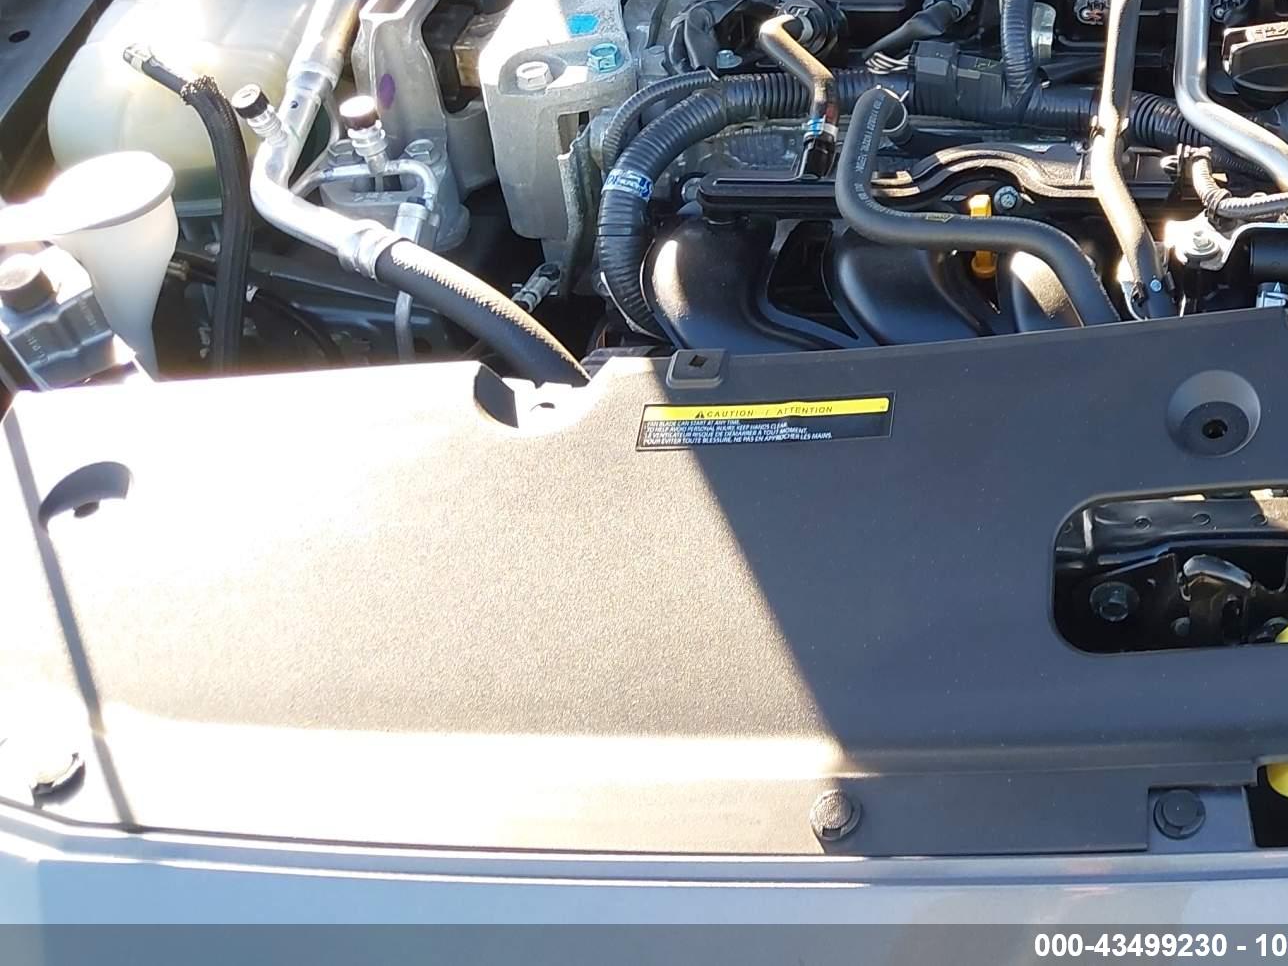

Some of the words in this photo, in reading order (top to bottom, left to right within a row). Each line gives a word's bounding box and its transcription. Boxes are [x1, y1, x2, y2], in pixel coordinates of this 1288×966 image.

[706, 409, 754, 418] CAUTION
[776, 405, 834, 416] ATTENTION
[682, 436, 701, 444] TOUTE
[763, 434, 800, 442] APPROCHER
